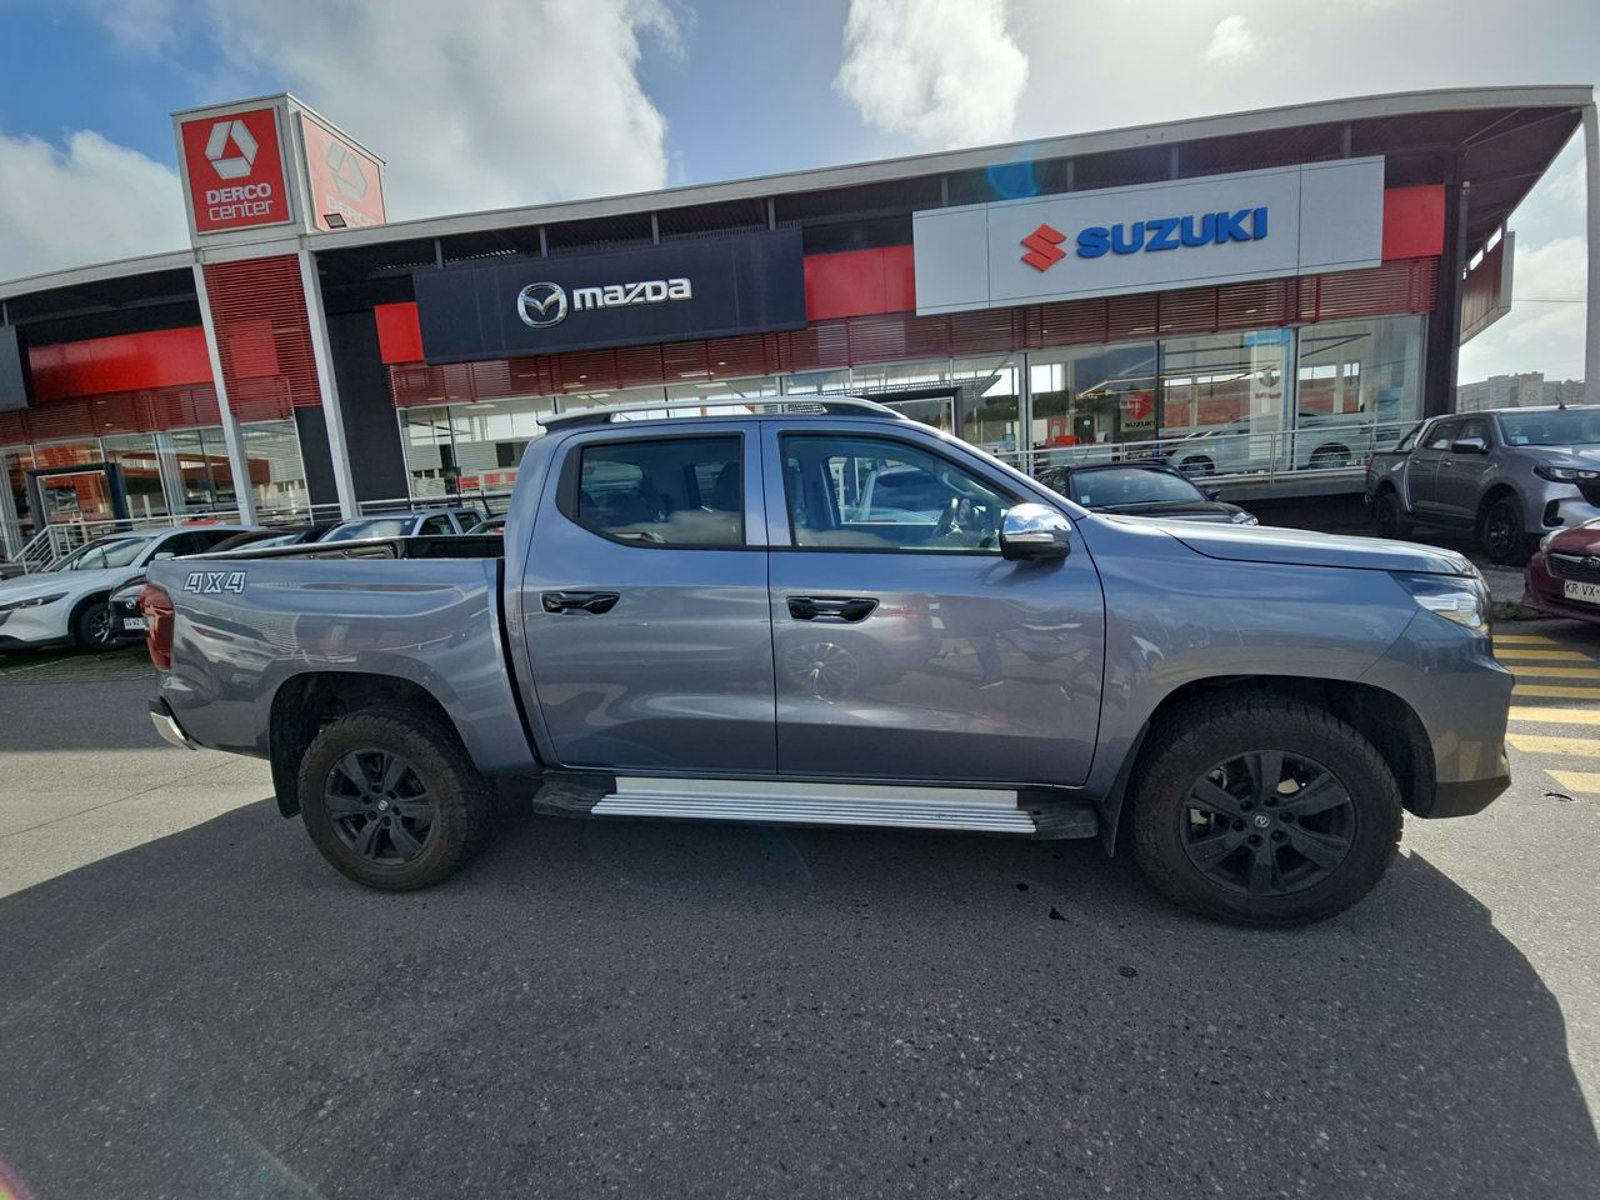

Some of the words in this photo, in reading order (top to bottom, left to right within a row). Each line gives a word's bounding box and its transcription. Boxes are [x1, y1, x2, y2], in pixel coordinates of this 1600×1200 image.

[205, 182, 272, 205] DERCO
[208, 200, 273, 221] center
[1076, 206, 1268, 259] SUZUKI
[572, 277, 693, 312] mazda
